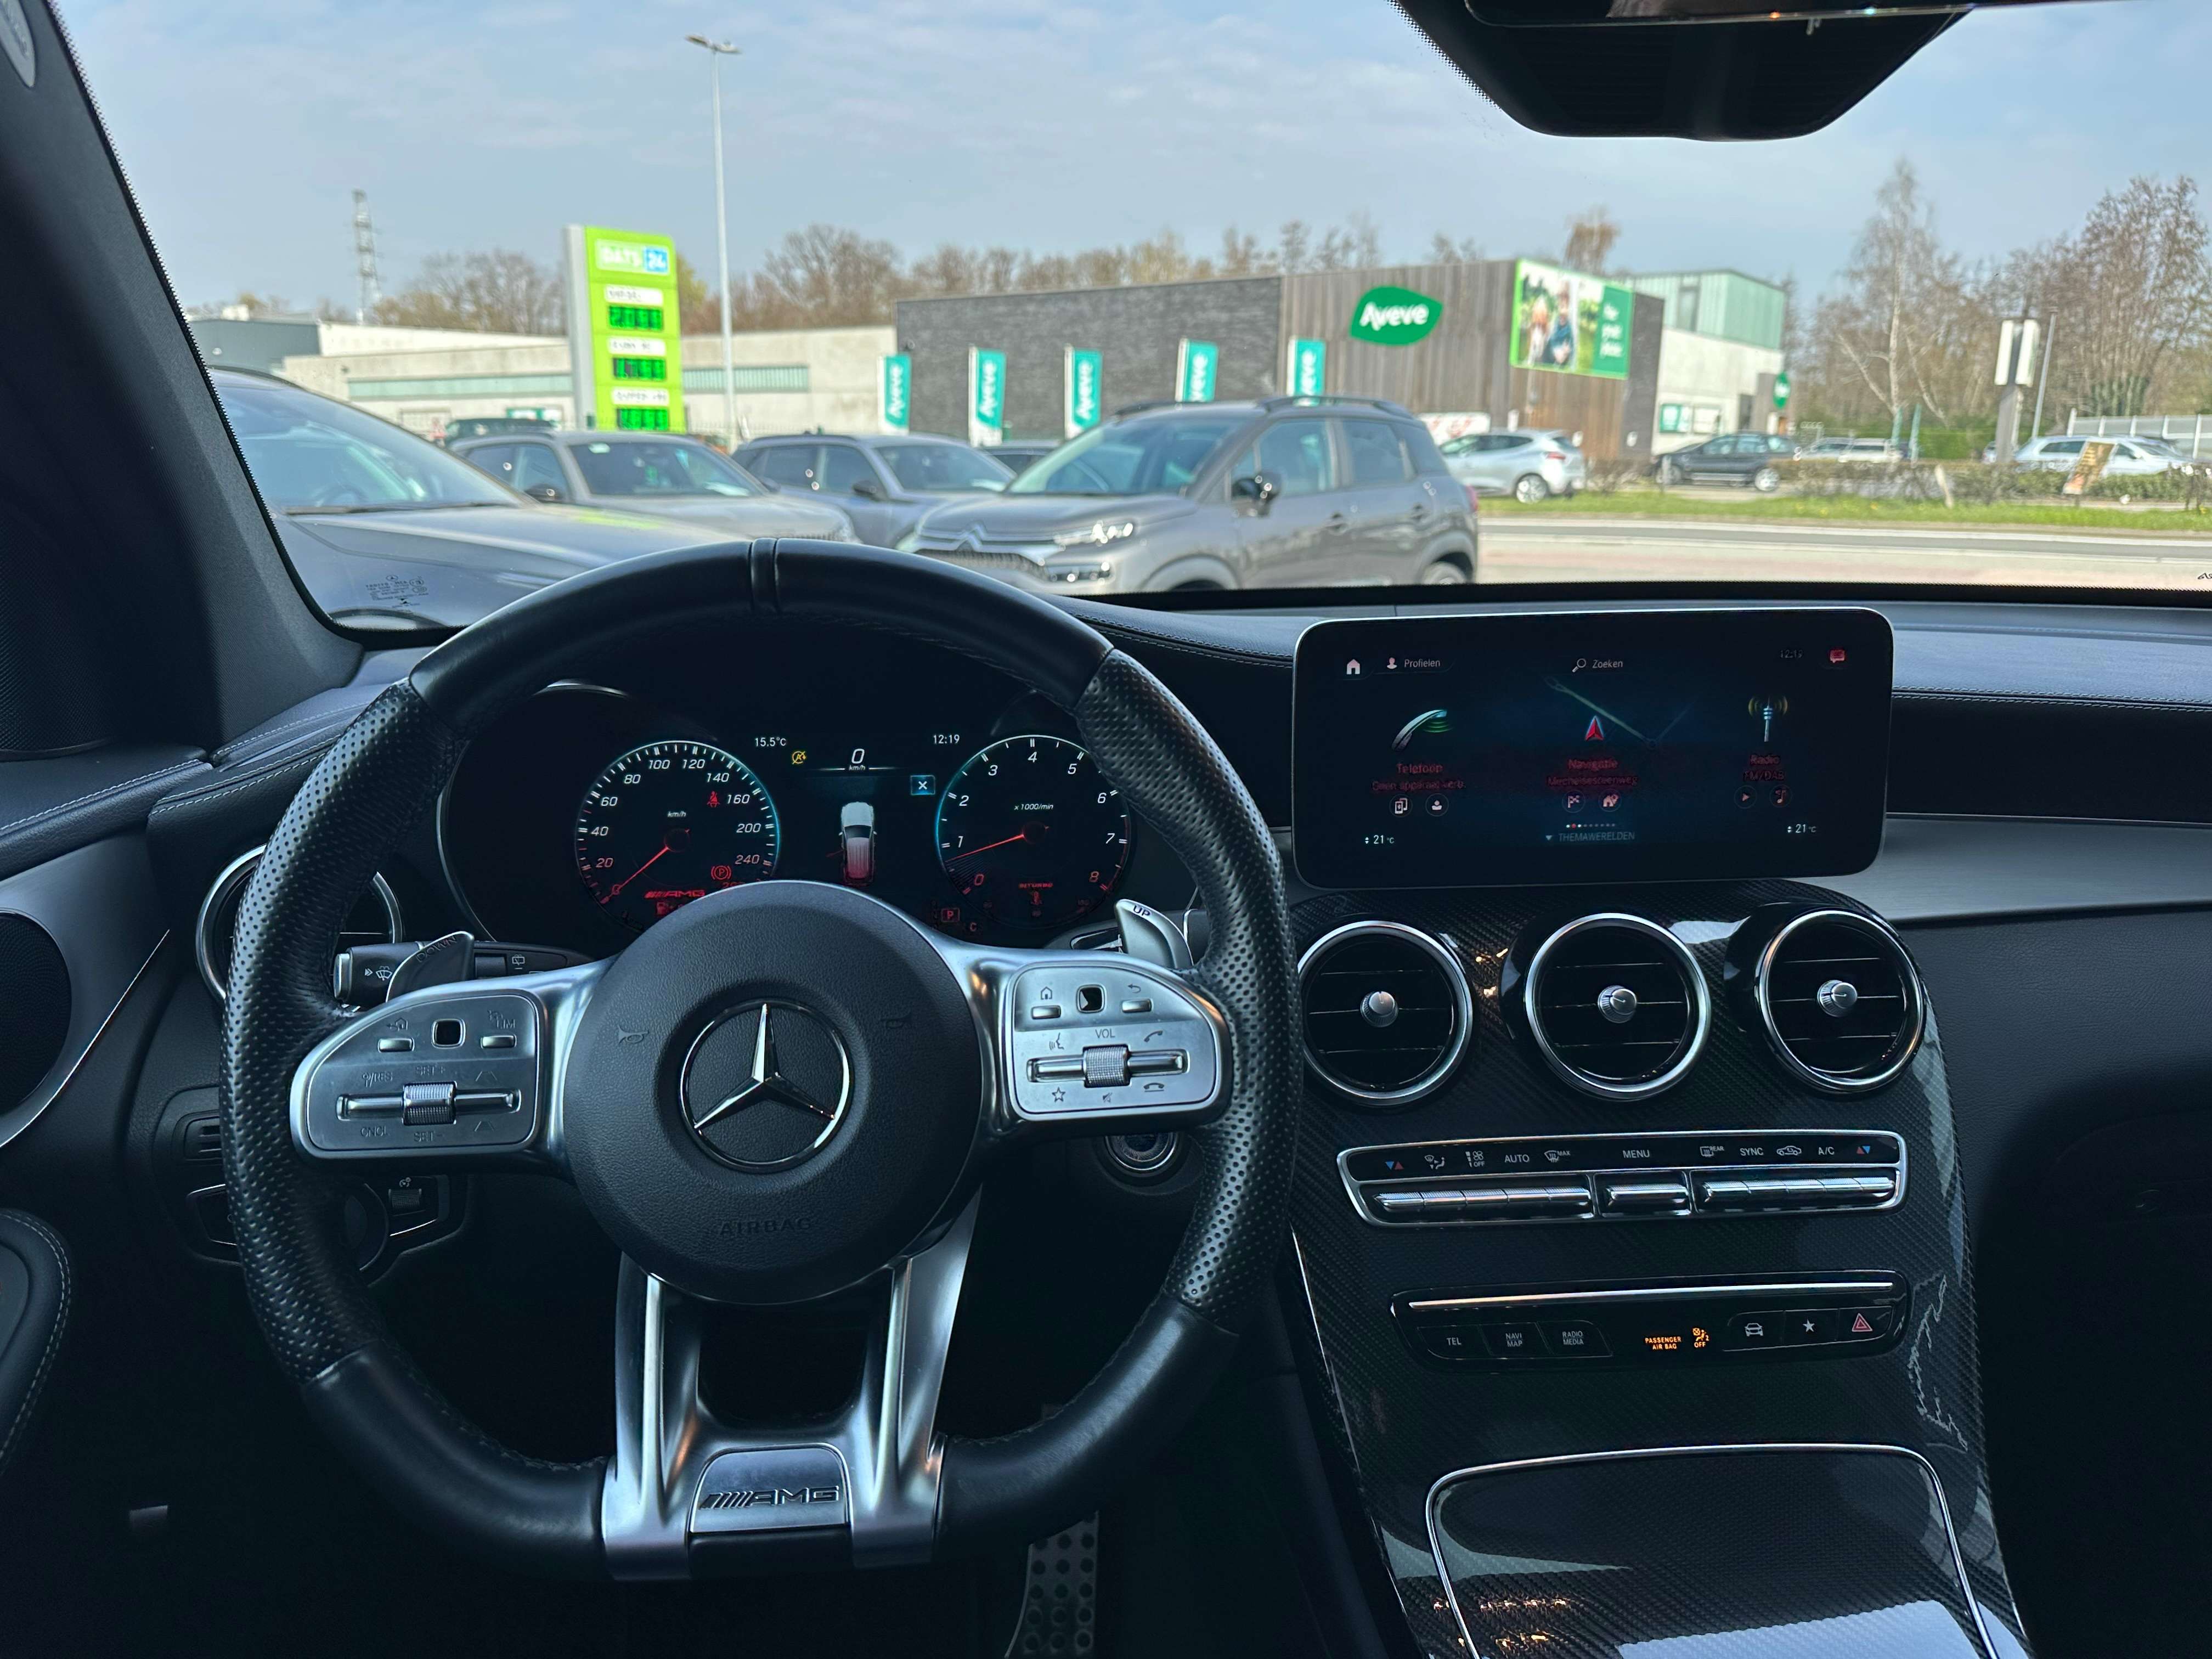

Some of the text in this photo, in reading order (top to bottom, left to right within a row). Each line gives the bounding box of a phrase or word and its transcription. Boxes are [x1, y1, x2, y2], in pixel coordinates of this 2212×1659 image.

[1359, 301, 1429, 331] Aveve
[1404, 658, 1441, 668] Profielen
[1592, 659, 1623, 669] Zoeken
[933, 734, 960, 744] 12:19
[851, 748, 865, 764] 0
[1028, 752, 1037, 763] 4
[648, 759, 670, 769] 100
[682, 759, 705, 769] 120
[988, 765, 998, 776] 3
[1067, 764, 1077, 775] 5
[624, 774, 641, 784] 80
[707, 773, 729, 782] 140
[601, 797, 618, 806] 60
[727, 794, 750, 804] 160
[959, 795, 969, 806] 2
[1097, 792, 1107, 804] 6
[591, 827, 608, 836] 40
[736, 823, 760, 833] 200
[958, 836, 964, 848] 1
[1105, 833, 1115, 844] 7
[1559, 832, 1635, 842] THEMAWERELDEN
[596, 858, 613, 868] 20
[735, 855, 759, 864] 240
[974, 873, 984, 885] 0
[1090, 871, 1099, 882] 8
[1133, 905, 1151, 917] UP
[416, 935, 457, 963] DOWN
[1095, 1029, 1115, 1039] VOL
[1623, 1150, 1650, 1159] MENU
[1740, 1147, 1764, 1156] SYNC
[1818, 1146, 1835, 1155] A/C
[1504, 1154, 1530, 1164] AUTO
[718, 1217, 811, 1235] AIRBAG
[1447, 1338, 1462, 1346] TEL
